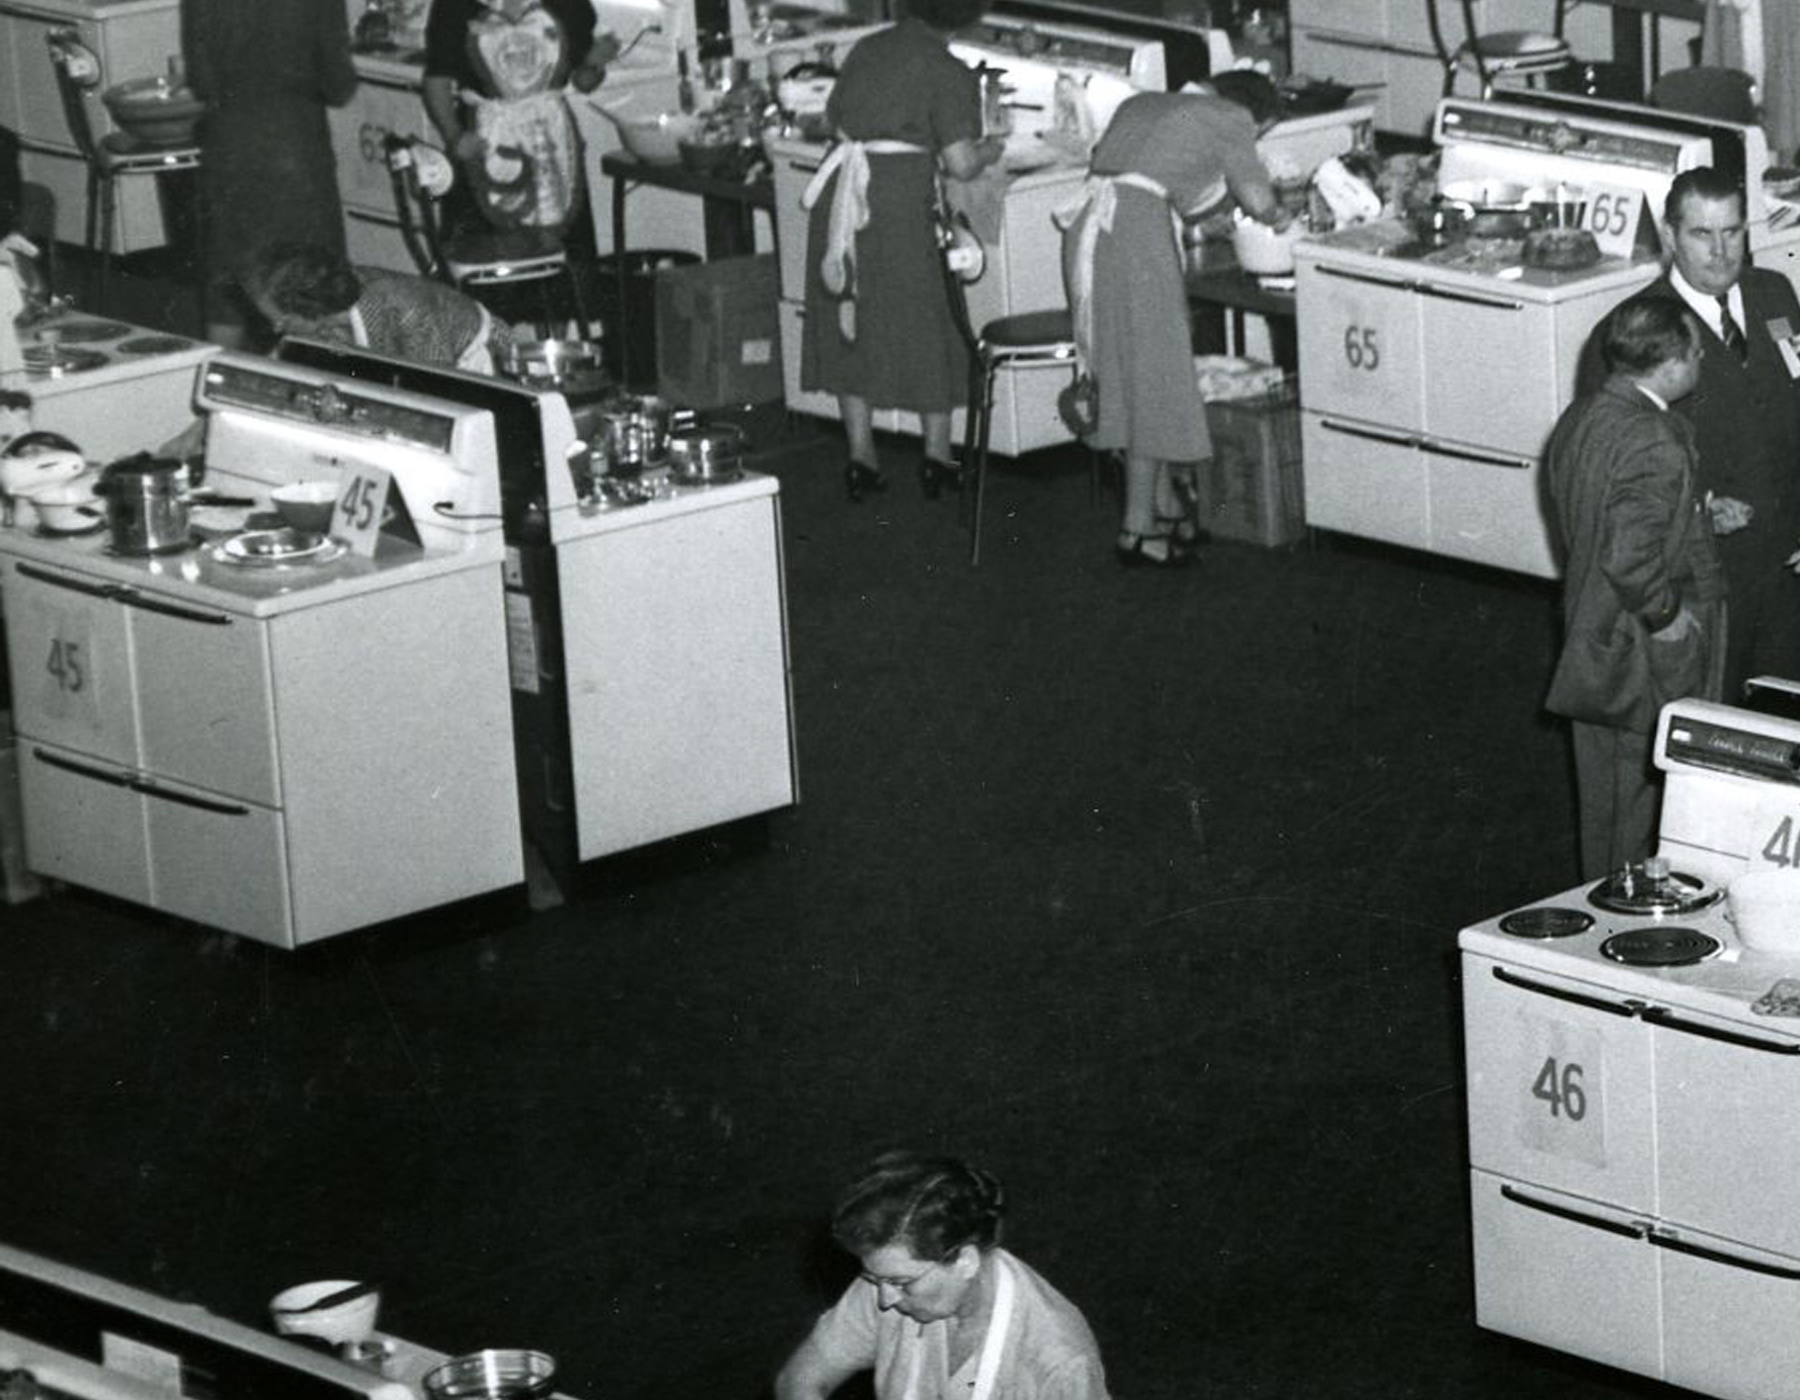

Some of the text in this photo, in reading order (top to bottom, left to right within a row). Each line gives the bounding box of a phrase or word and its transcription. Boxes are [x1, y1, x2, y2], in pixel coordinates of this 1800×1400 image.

[1591, 193, 1629, 236] 65
[1344, 325, 1379, 371] 65
[342, 475, 378, 532] 45
[48, 638, 84, 693] 45
[1531, 1056, 1587, 1122] 46
